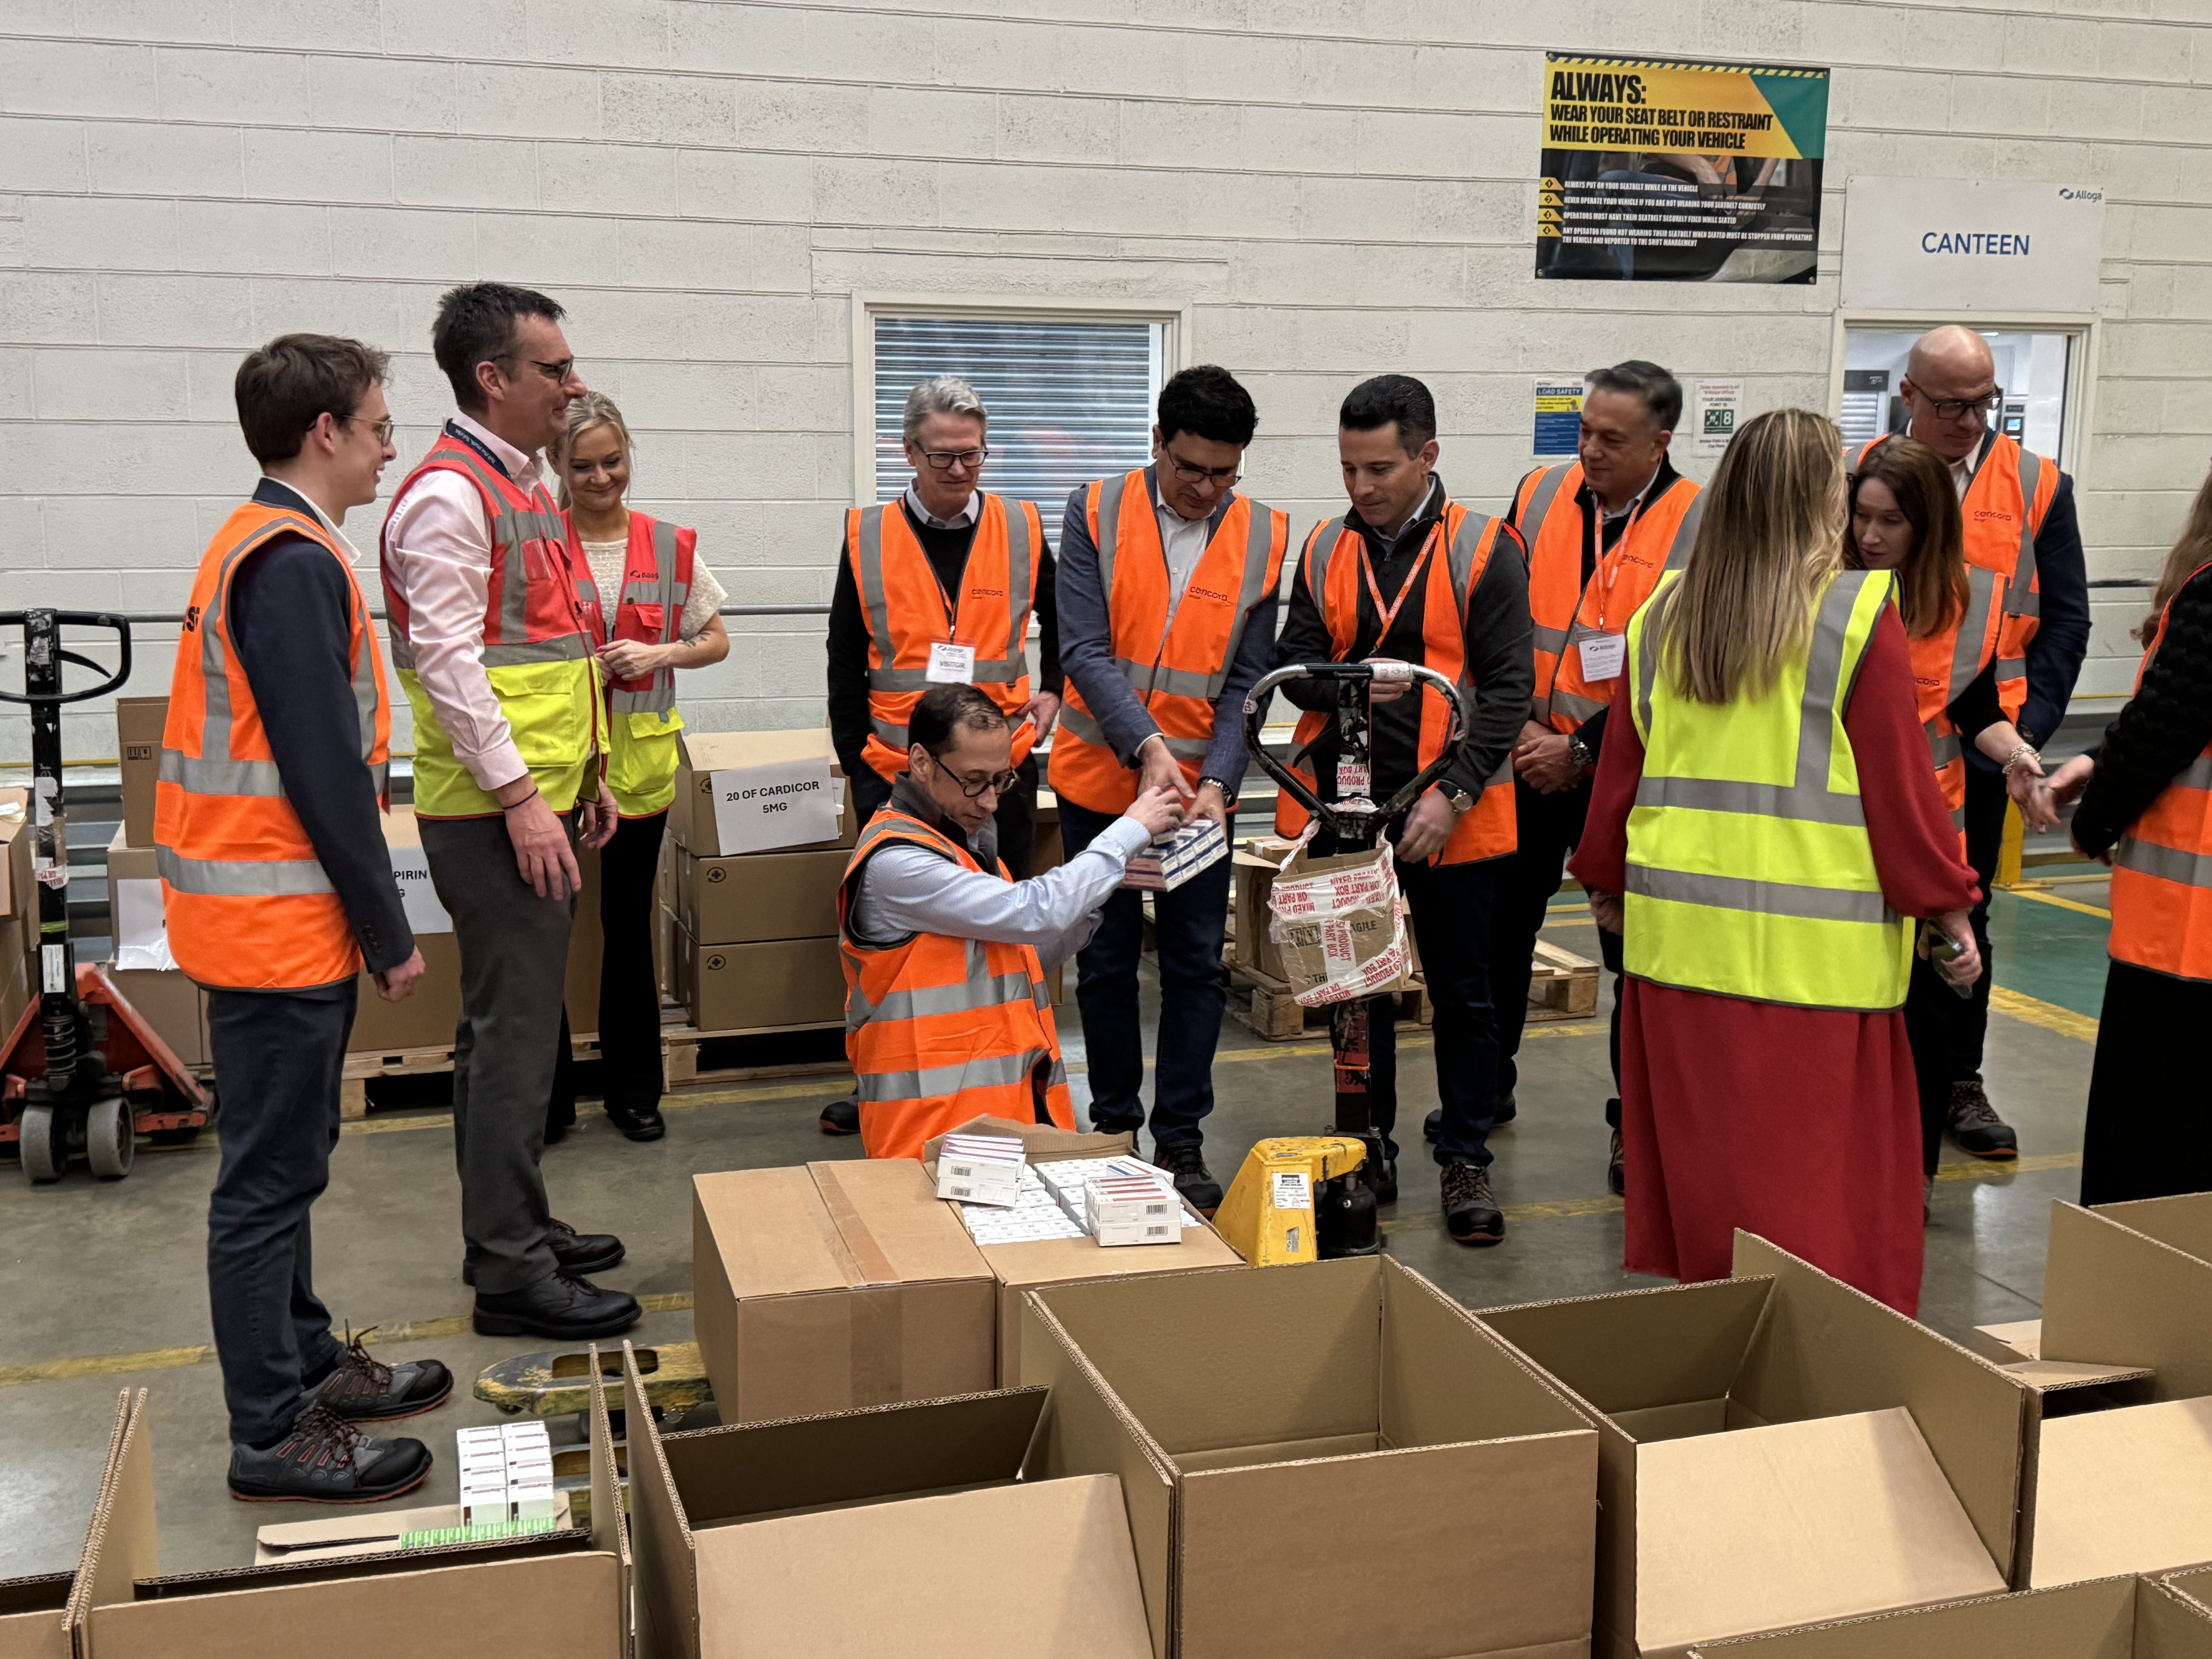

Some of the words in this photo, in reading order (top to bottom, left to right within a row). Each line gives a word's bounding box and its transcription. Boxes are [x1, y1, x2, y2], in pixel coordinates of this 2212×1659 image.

[1551, 71, 1647, 104] ALWAYS:
[1551, 104, 1587, 122] WEAR
[1590, 106, 1623, 124] YOUR
[1626, 107, 1656, 125] SEAT
[1658, 109, 1687, 126] BELT
[1688, 110, 1705, 127] OR
[1707, 112, 1773, 131] RESTRAINT
[1550, 125, 1589, 143] WHILE
[1591, 126, 1660, 146] OPERATING
[1662, 129, 1695, 147] YOUR
[1697, 131, 1746, 149] VEHICLE
[2075, 190, 2102, 202] Alloga
[1715, 201, 1738, 209] SEATBELT
[1738, 202, 1766, 210] CORRECTLY
[1922, 232, 2030, 256] CANTEEN
[1723, 411, 1732, 425] 8
[1190, 586, 1227, 601] cencora
[726, 792, 739, 801] 20
[742, 789, 757, 799] OF
[760, 781, 819, 796] CARDICOR
[763, 802, 787, 813] 5MG
[394, 869, 427, 880] PIRIN
[1334, 885, 1349, 896] BOX
[1351, 881, 1368, 893] PART
[1279, 893, 1296, 905] PART
[1297, 891, 1307, 902] OR
[1293, 902, 1315, 914] MIXED
[1324, 925, 1336, 941] PART
[1338, 929, 1352, 961] PRODUCT
[1364, 965, 1394, 987] PRODUCT
